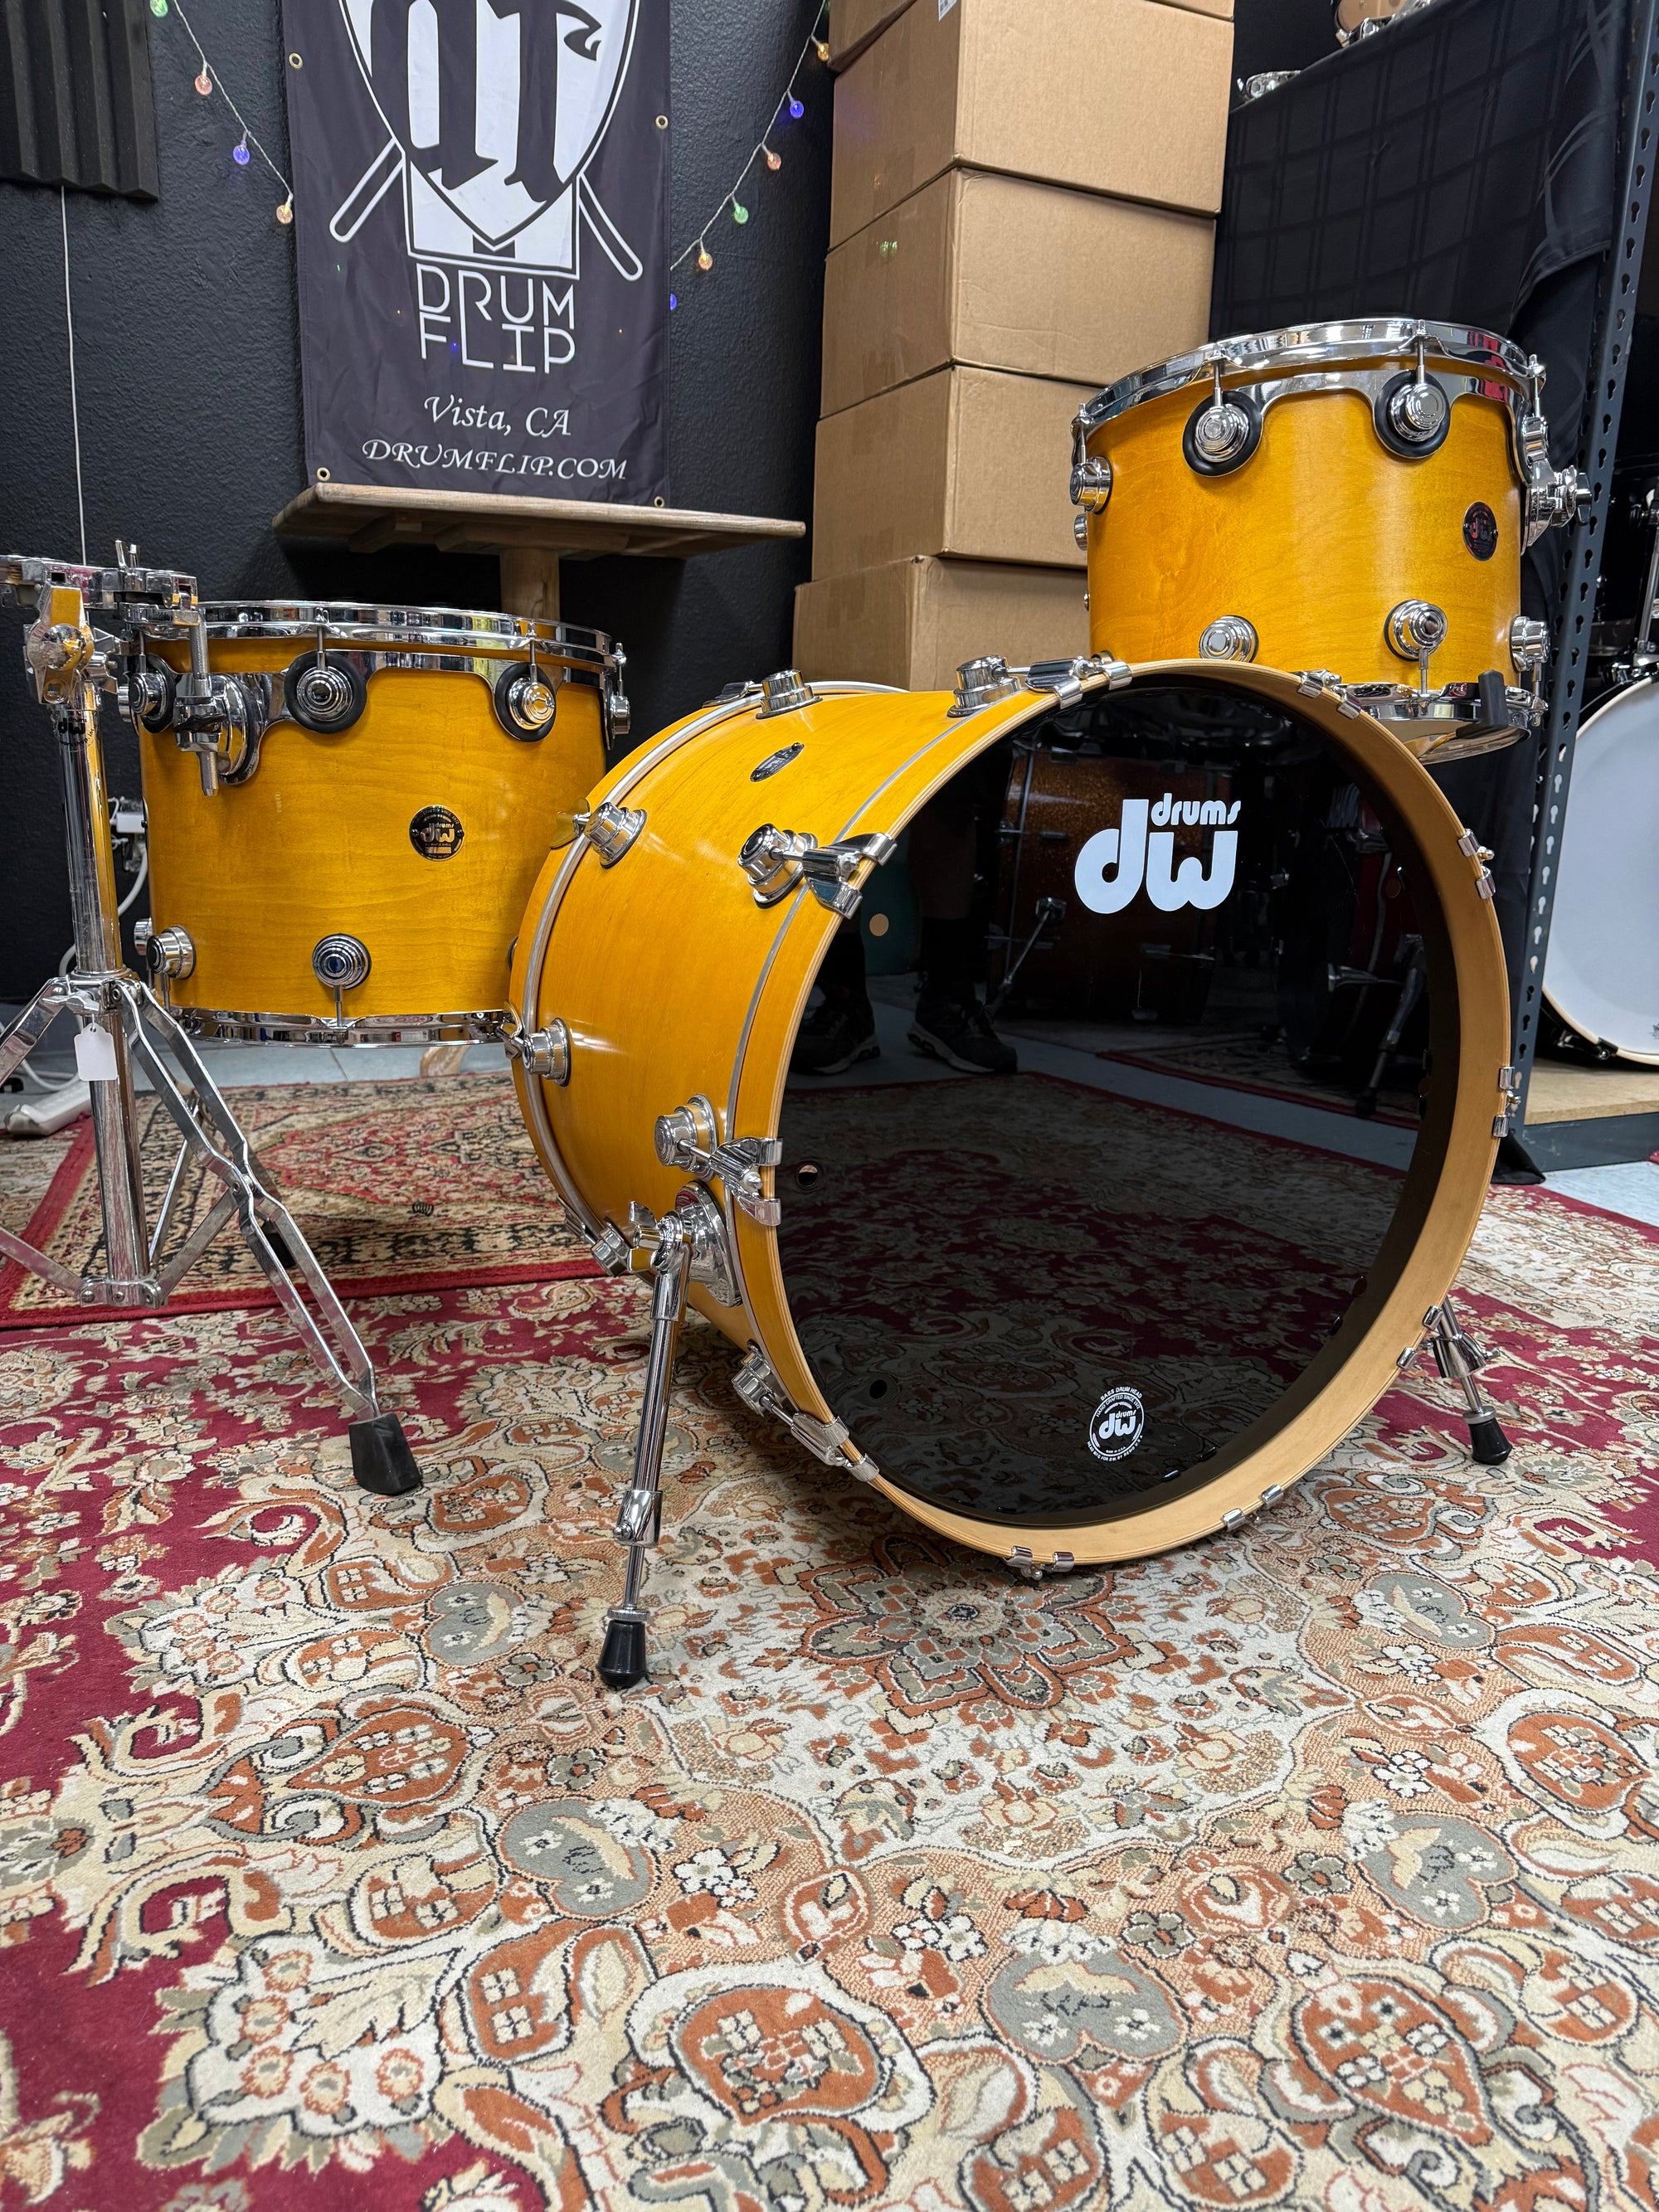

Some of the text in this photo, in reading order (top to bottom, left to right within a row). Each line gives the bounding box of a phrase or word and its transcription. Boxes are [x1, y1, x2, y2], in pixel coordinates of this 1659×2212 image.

[417, 263, 574, 329] DRUM
[419, 311, 575, 373] FLIP
[423, 395, 572, 437] Vista, CA
[361, 438, 628, 480] DRUMFLIP.COM
[1151, 792, 1242, 827] drums
[420, 822, 455, 843] dw
[1074, 798, 1238, 915] dw
[1100, 1388, 1115, 1402] BASS
[1130, 1387, 1143, 1399] HEAD
[1105, 1394, 1123, 1406] CRAFTED
[1123, 1394, 1135, 1403] SINCE
[1098, 1412, 1136, 1440] dw
[1115, 1409, 1137, 1419] drums
